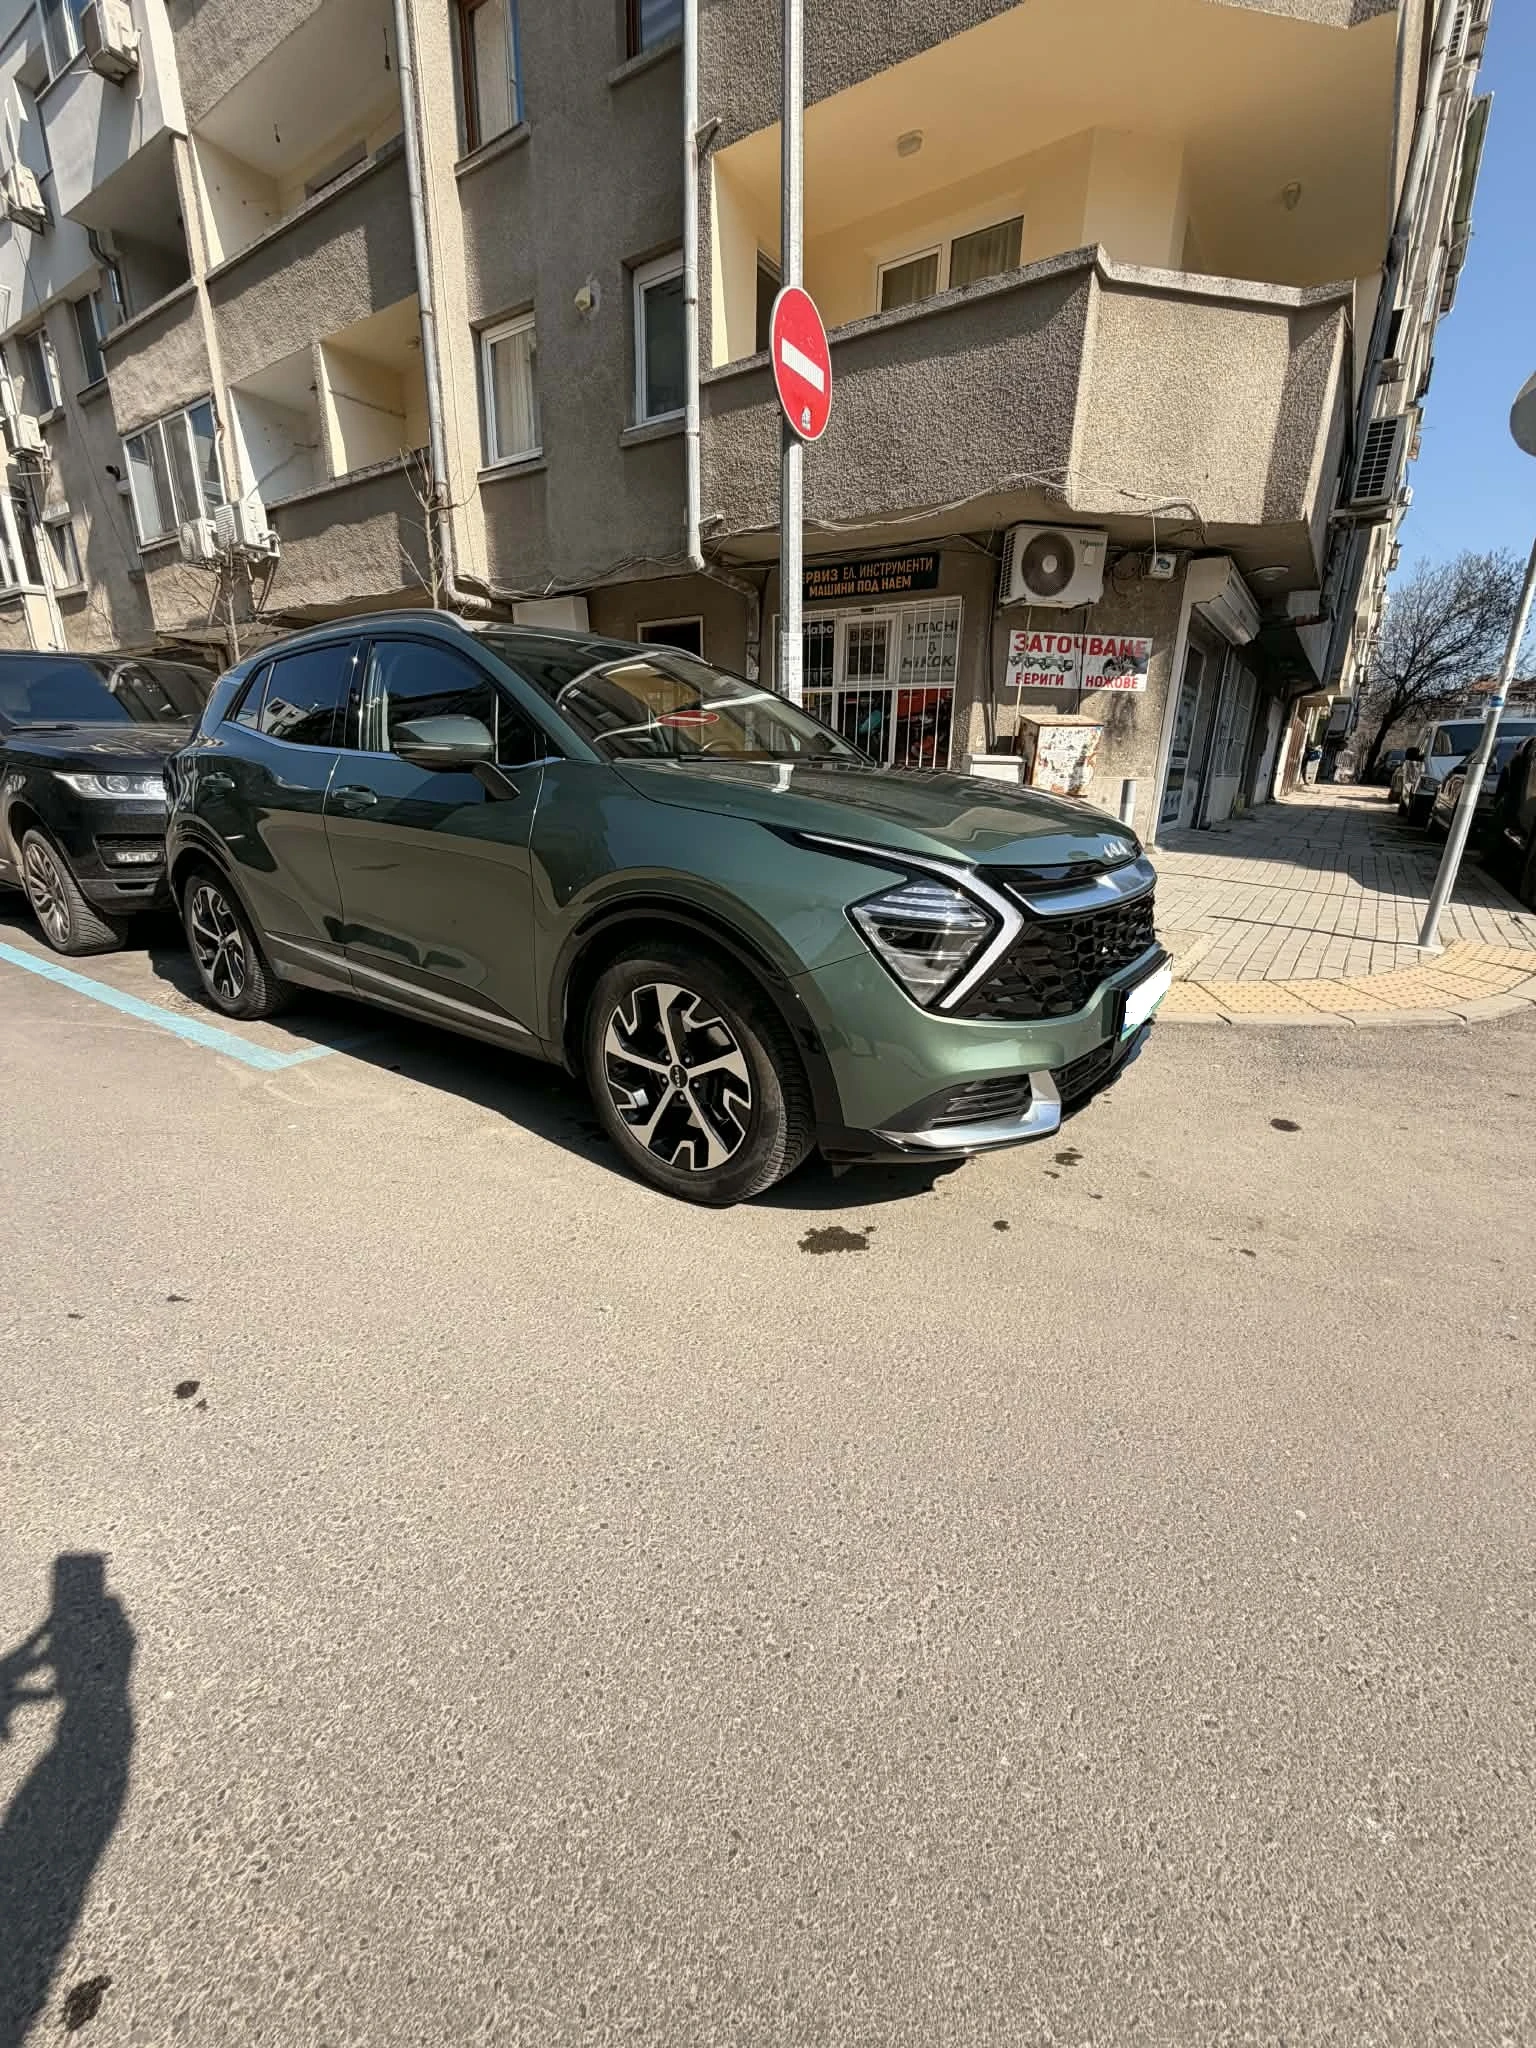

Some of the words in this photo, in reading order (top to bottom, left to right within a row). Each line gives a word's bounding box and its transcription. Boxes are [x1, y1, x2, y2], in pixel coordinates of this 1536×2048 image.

[859, 557, 933, 579] ИНСТРУМЕНТИ
[809, 582, 855, 597] МАШИНИ
[857, 580, 879, 592] ПОД
[882, 576, 912, 590] НАЕМ
[908, 620, 958, 635] HITACHI
[1014, 633, 1148, 658] ЗАТОЧВАНЕ
[1086, 674, 1137, 689] НОЖОВЕ
